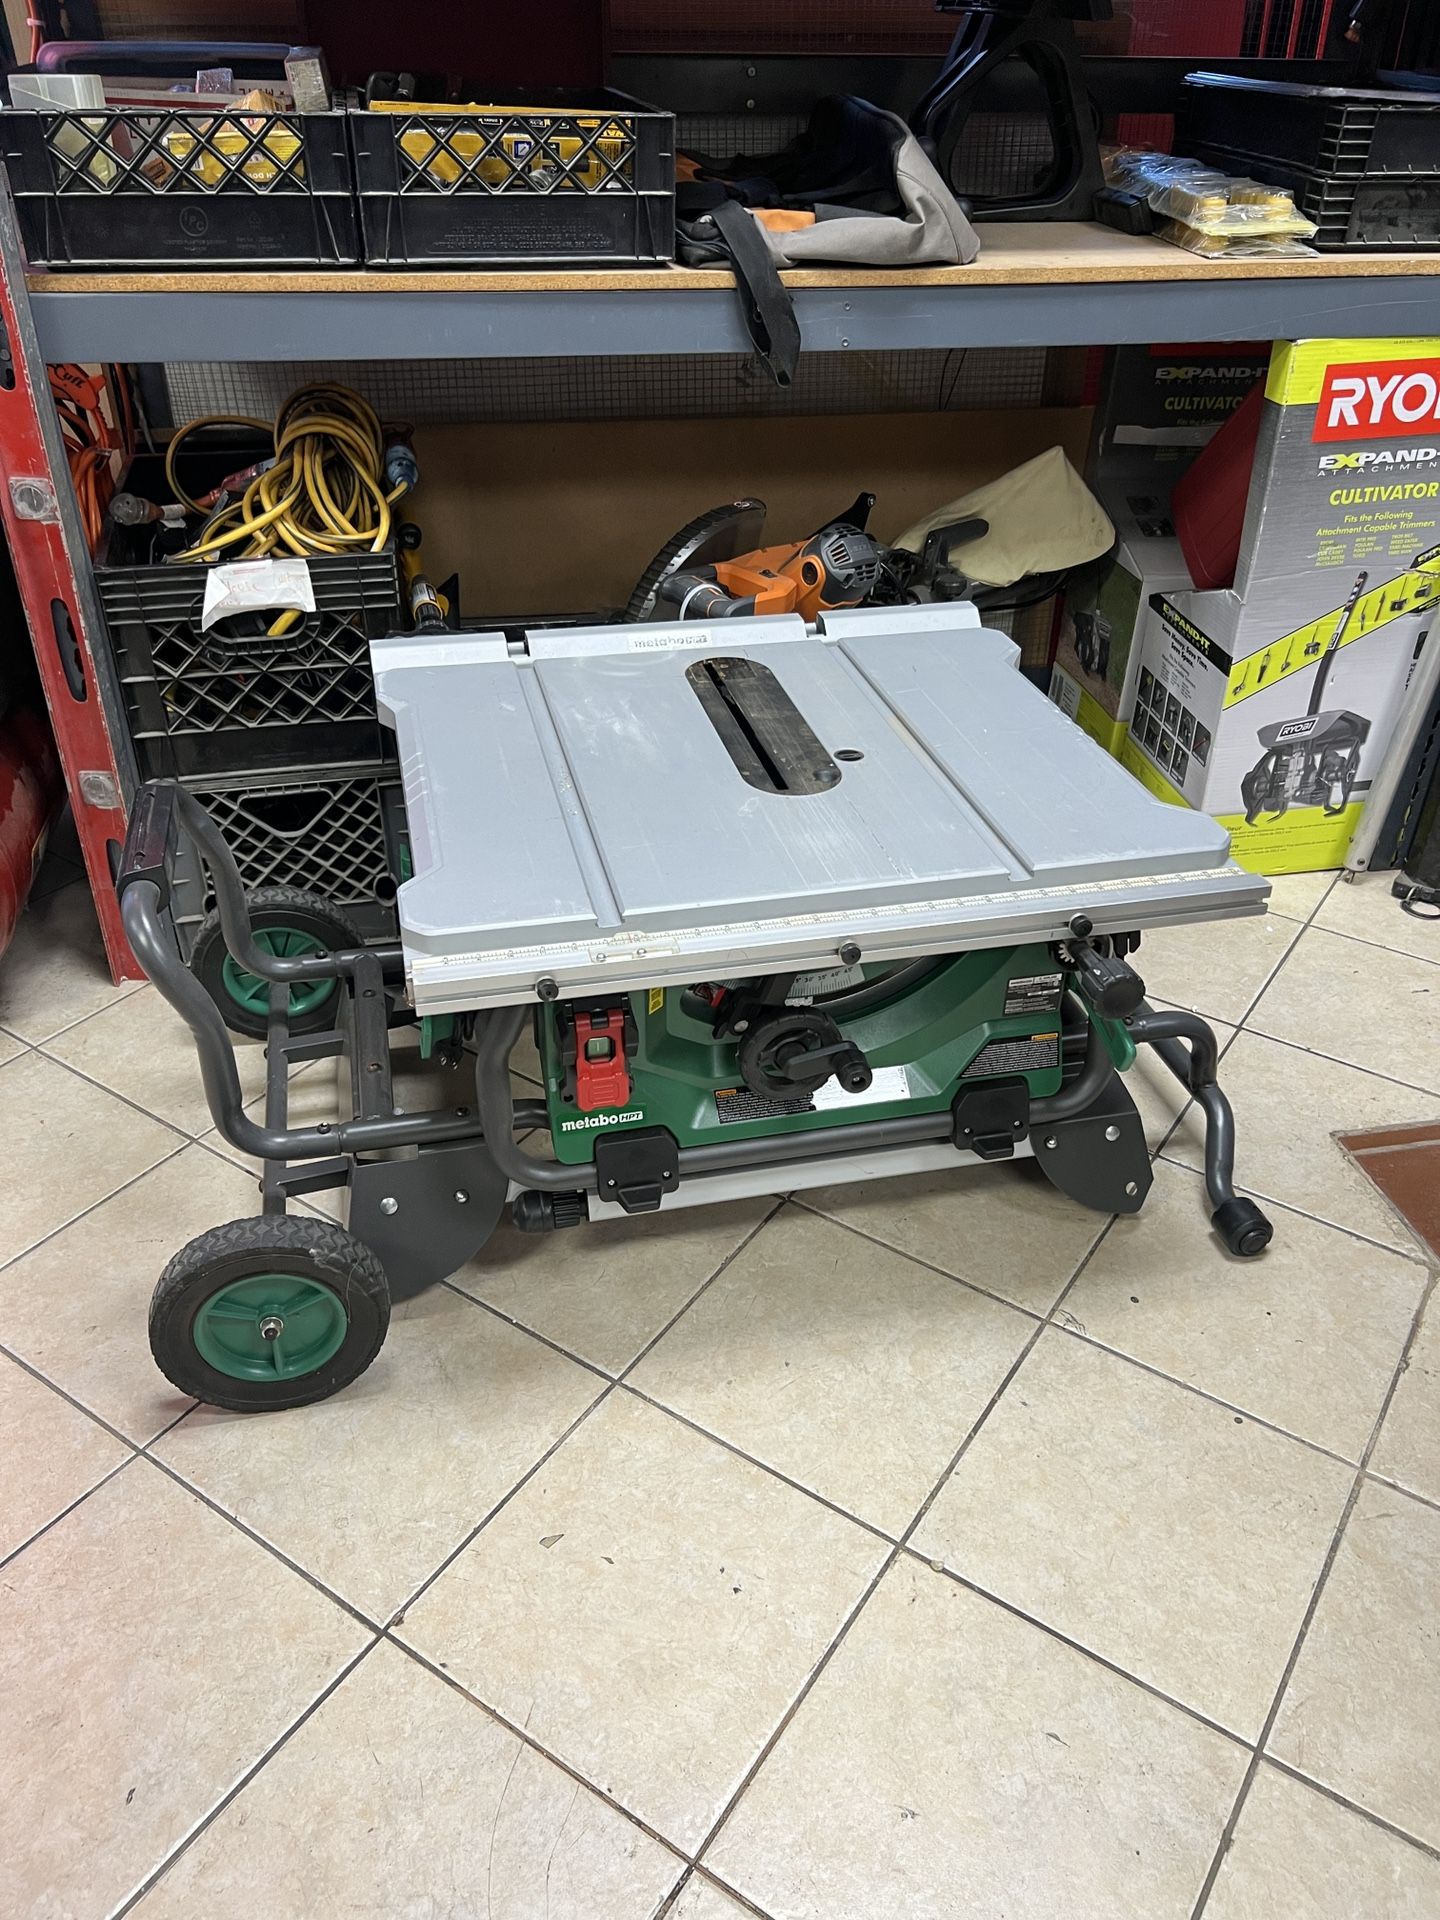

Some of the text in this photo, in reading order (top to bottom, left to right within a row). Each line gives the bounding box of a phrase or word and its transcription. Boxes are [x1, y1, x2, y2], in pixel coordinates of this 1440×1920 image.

[1326, 372, 1440, 428] RYO
[1329, 482, 1440, 506] CULTIVATOR
[1344, 510, 1414, 523] Fits the Following
[1315, 520, 1436, 537] Attachment Capable Trimmers
[1282, 721, 1314, 735] RYOBI
[561, 1111, 643, 1132] metabo HPT
